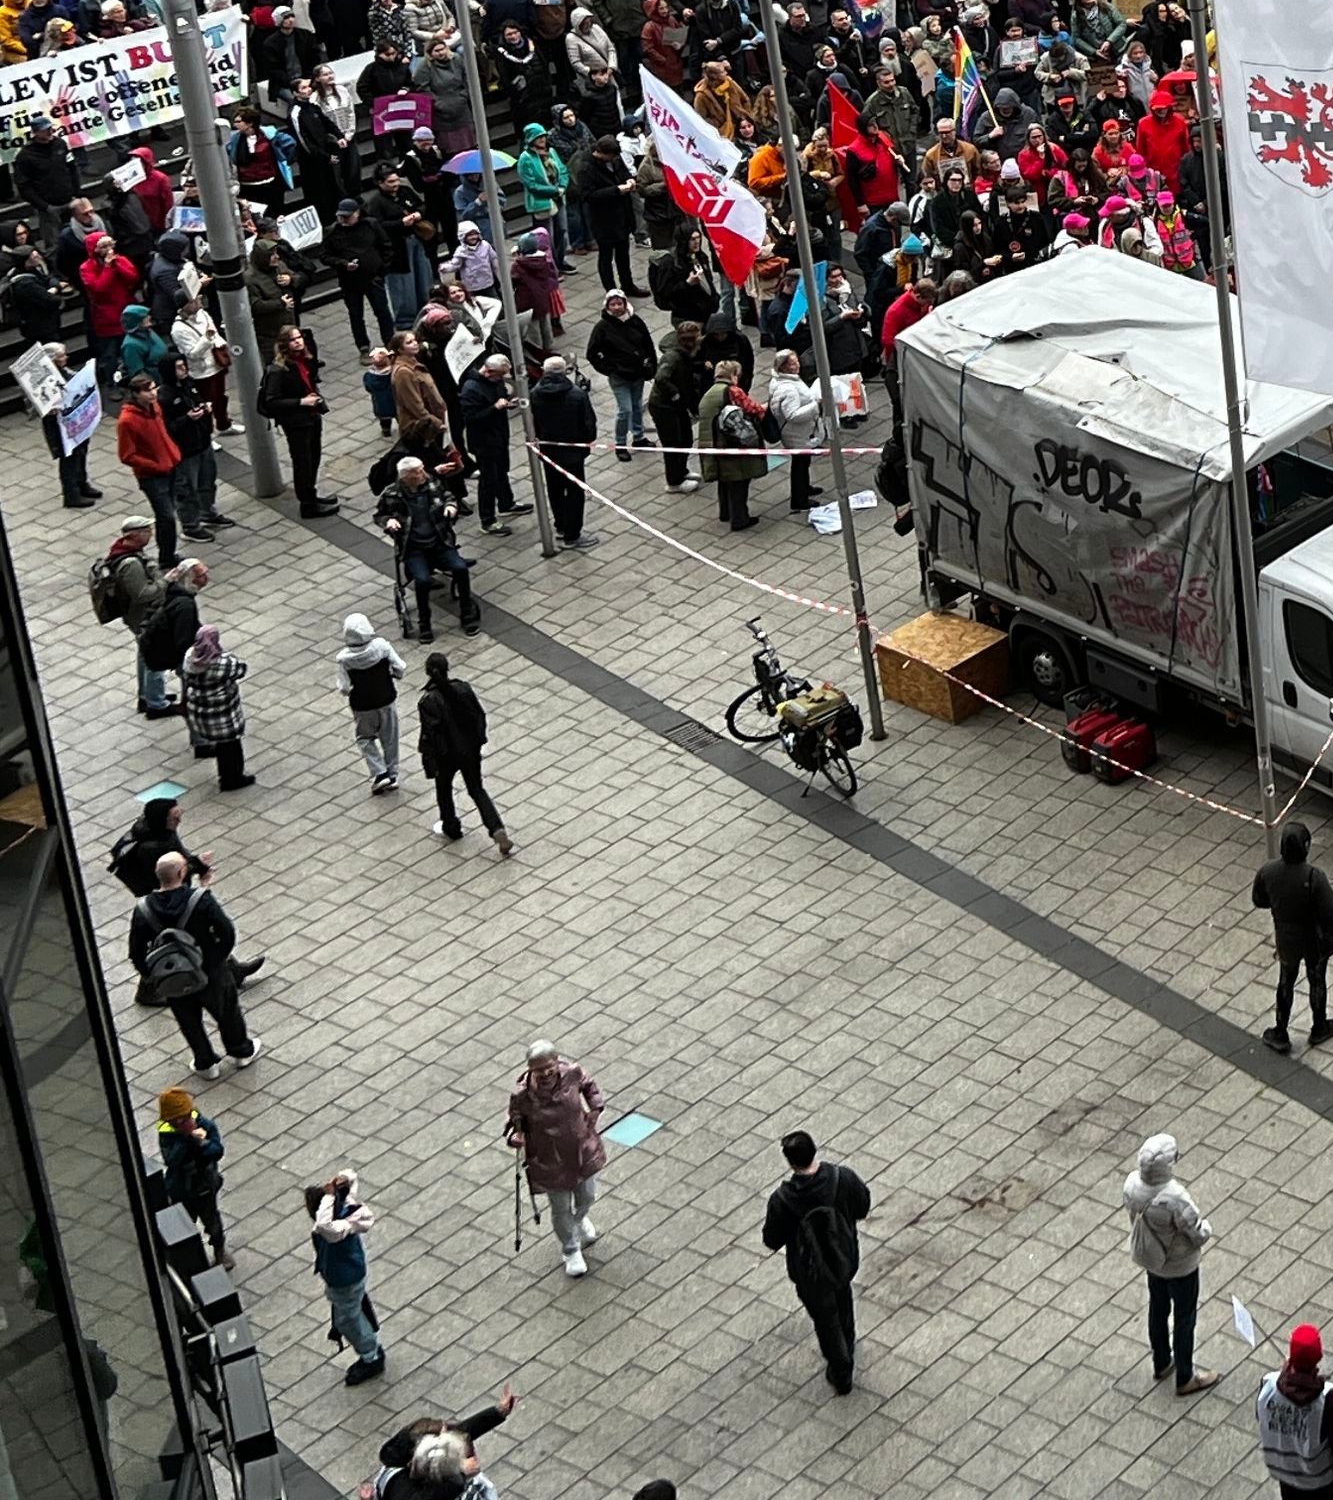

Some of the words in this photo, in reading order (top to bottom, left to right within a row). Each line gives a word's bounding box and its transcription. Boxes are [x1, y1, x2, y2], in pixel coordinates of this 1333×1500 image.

[65, 52, 118, 88] IST
[127, 23, 227, 71] BUT
[50, 93, 99, 120] eine
[103, 72, 179, 102] offene
